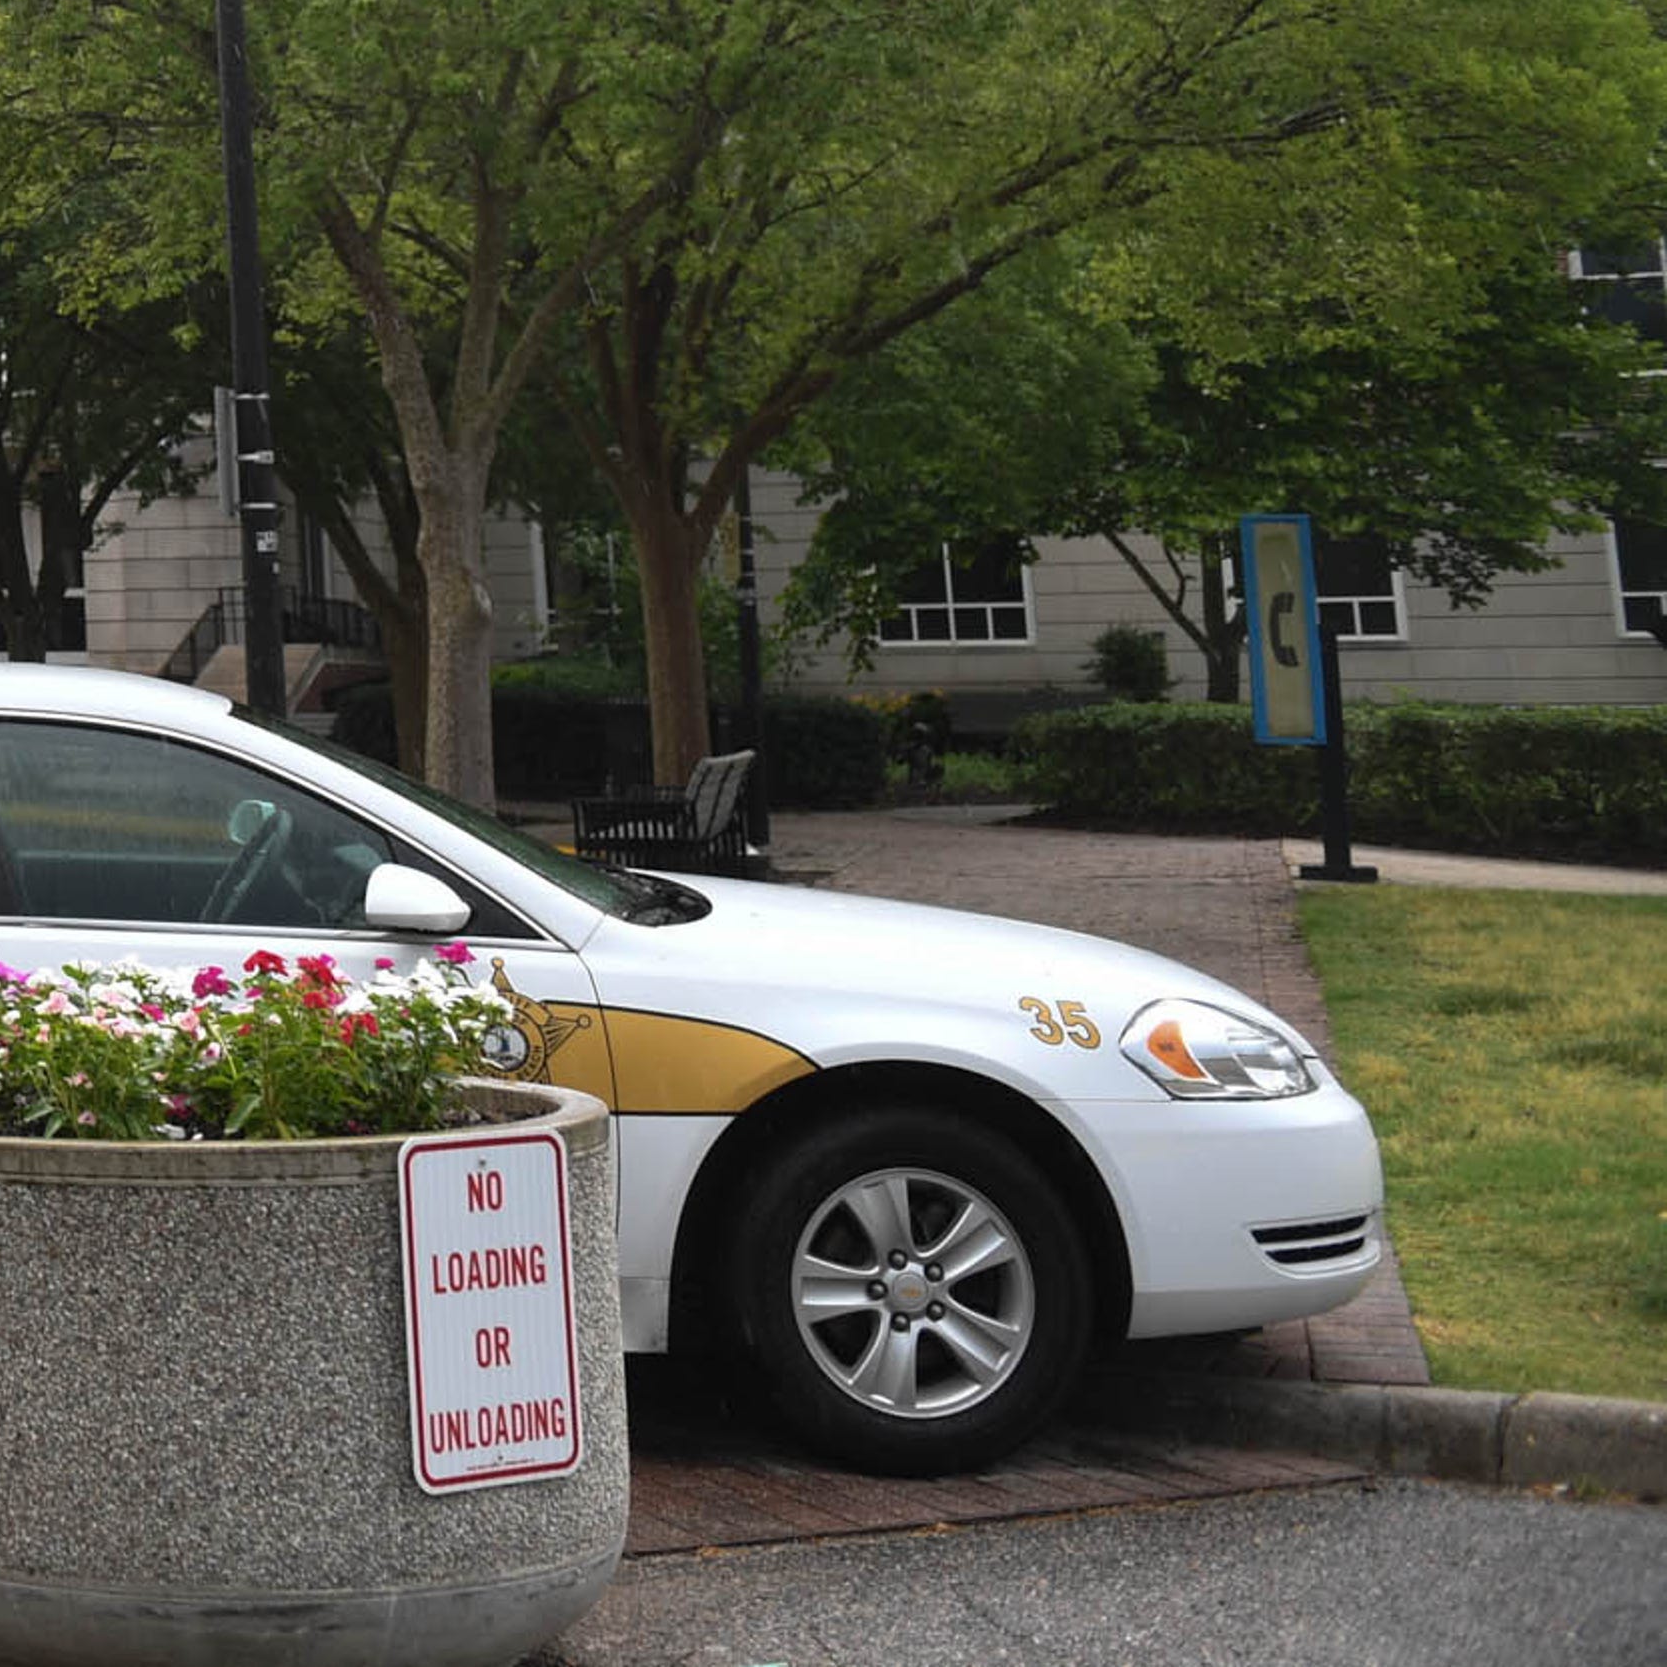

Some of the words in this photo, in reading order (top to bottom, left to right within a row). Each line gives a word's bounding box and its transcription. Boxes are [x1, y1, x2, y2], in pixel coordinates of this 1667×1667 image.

[1018, 996, 1101, 1050] 35
[467, 1170, 504, 1212] NO
[432, 1243, 546, 1294] LOADING
[475, 1326, 512, 1369] OR
[429, 1398, 566, 1454] UNLOADING
